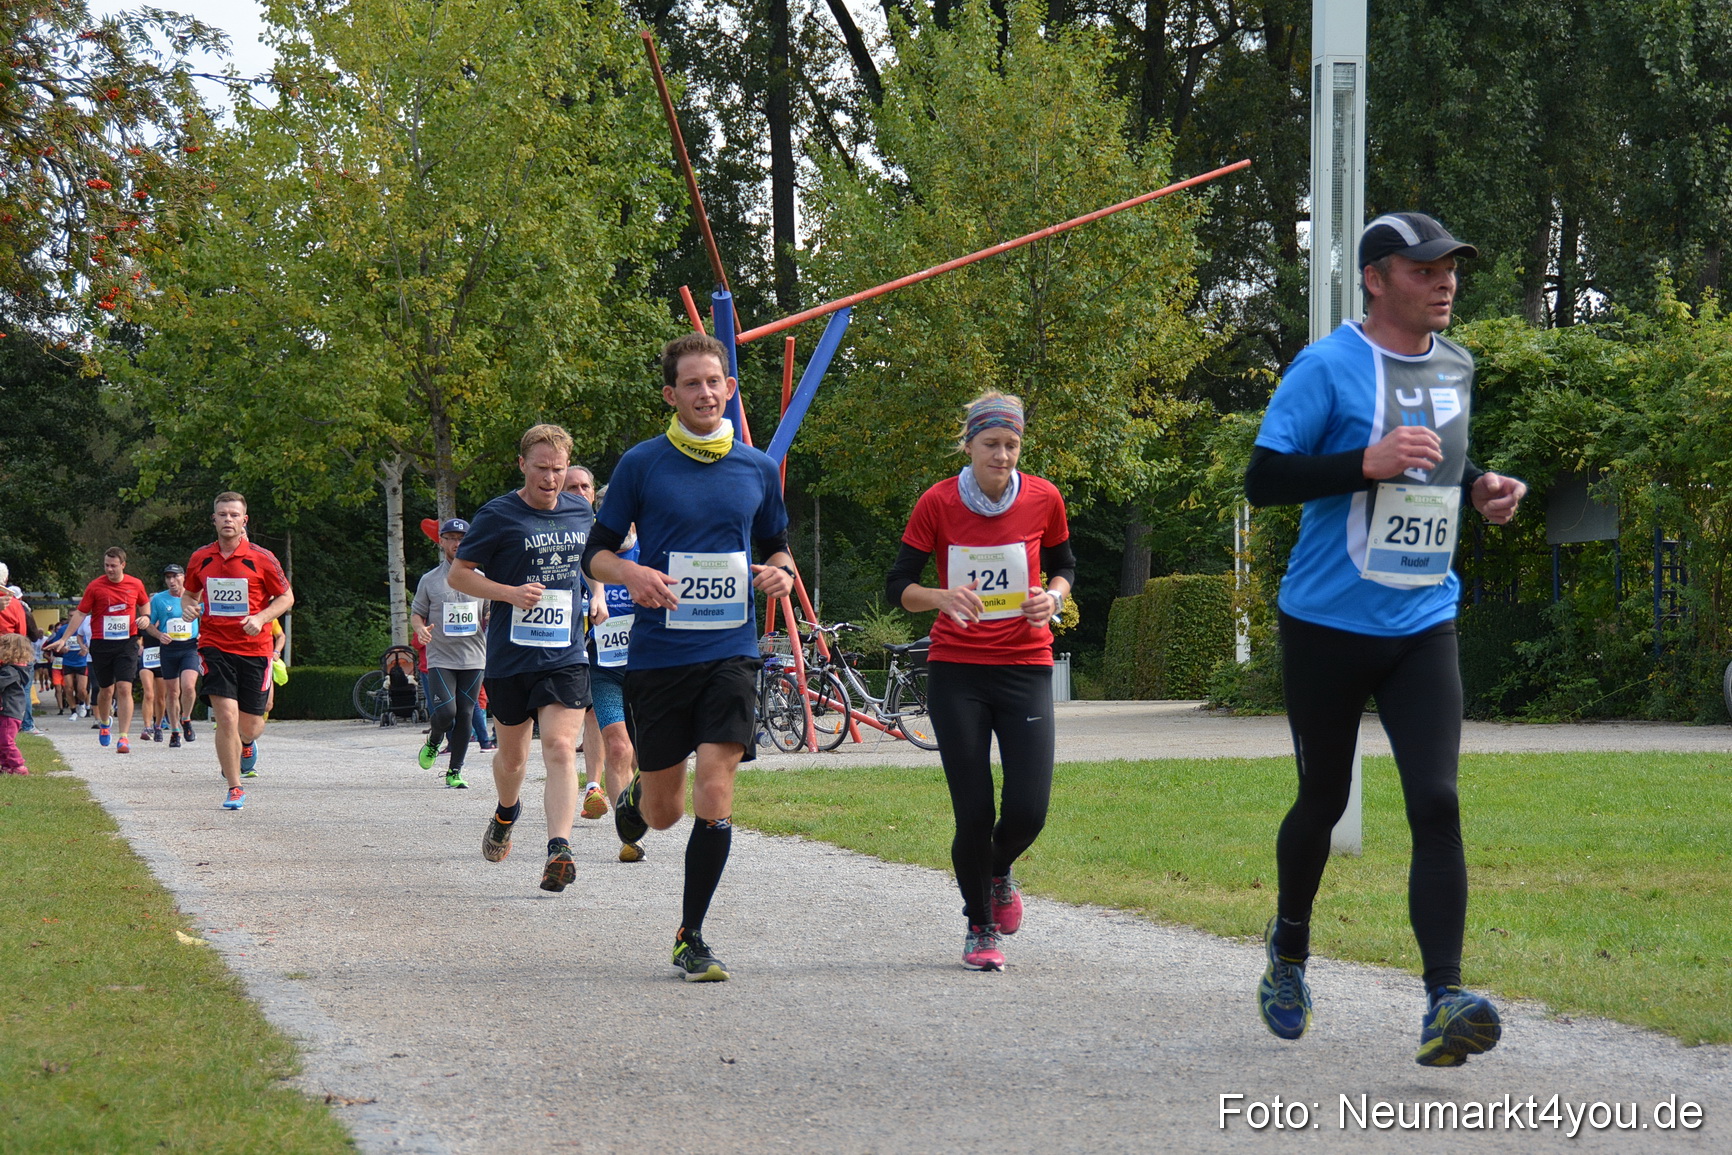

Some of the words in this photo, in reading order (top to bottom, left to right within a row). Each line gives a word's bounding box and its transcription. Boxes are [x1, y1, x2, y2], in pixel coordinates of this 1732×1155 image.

[1384, 515, 1448, 546] 2516
[524, 531, 586, 551] AUCKLAND
[538, 544, 576, 554] UNIVERSITY
[1401, 556, 1430, 568] Rudolf
[526, 575, 541, 583] NZA
[542, 574, 555, 582] SEA
[967, 568, 1009, 591] 124
[680, 576, 737, 600] 2558
[213, 589, 242, 602] 2223
[448, 612, 473, 623] 2160
[521, 606, 564, 625] 2205
[691, 607, 725, 616] Andreas
[107, 622, 127, 631] 2498
[173, 624, 187, 632] 134
[530, 629, 555, 638] Michael
[601, 630, 632, 649] 246
